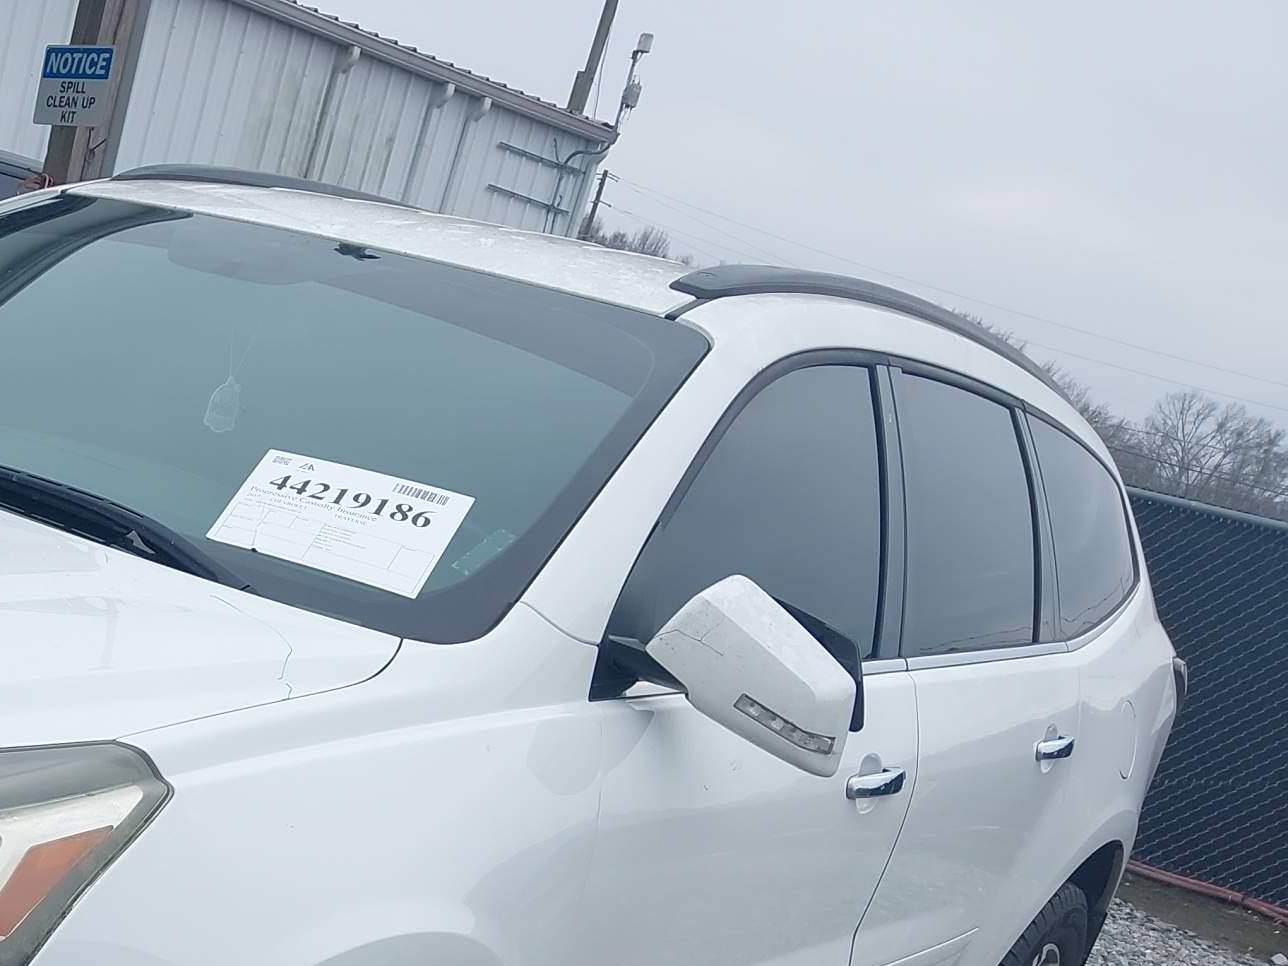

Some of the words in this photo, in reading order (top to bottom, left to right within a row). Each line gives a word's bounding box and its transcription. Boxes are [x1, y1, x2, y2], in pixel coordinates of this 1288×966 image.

[46, 52, 110, 75] NOTICE
[59, 81, 86, 94] SPILL
[46, 95, 78, 108] CLEAN
[81, 96, 96, 109] UP
[60, 110, 76, 123] KIT
[269, 474, 438, 528] 44219186
